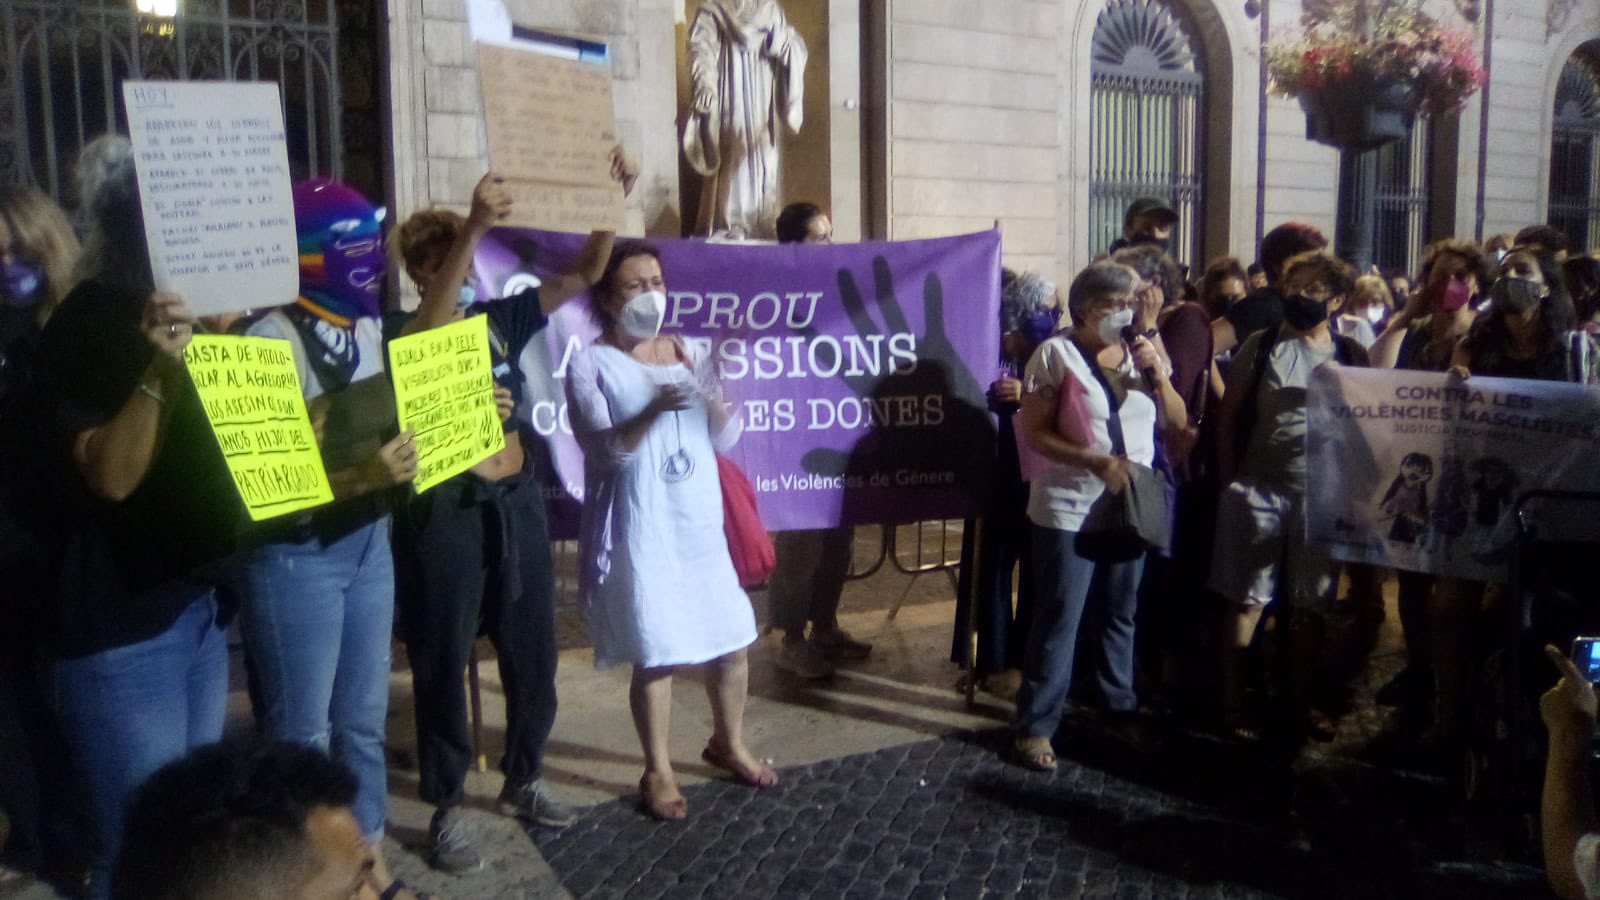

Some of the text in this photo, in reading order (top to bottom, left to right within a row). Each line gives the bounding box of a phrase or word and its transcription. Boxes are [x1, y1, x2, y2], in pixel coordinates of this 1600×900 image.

[133, 87, 168, 104] HOY
[664, 291, 823, 331] PROU
[236, 343, 252, 362] DE
[227, 369, 242, 388] AL
[1395, 385, 1534, 410] CONTRA LES
[807, 395, 945, 431] DONES
[1392, 423, 1451, 437] JUSTICIA
[756, 473, 779, 493] les
[782, 468, 865, 491] Violències
[870, 470, 889, 487] de
